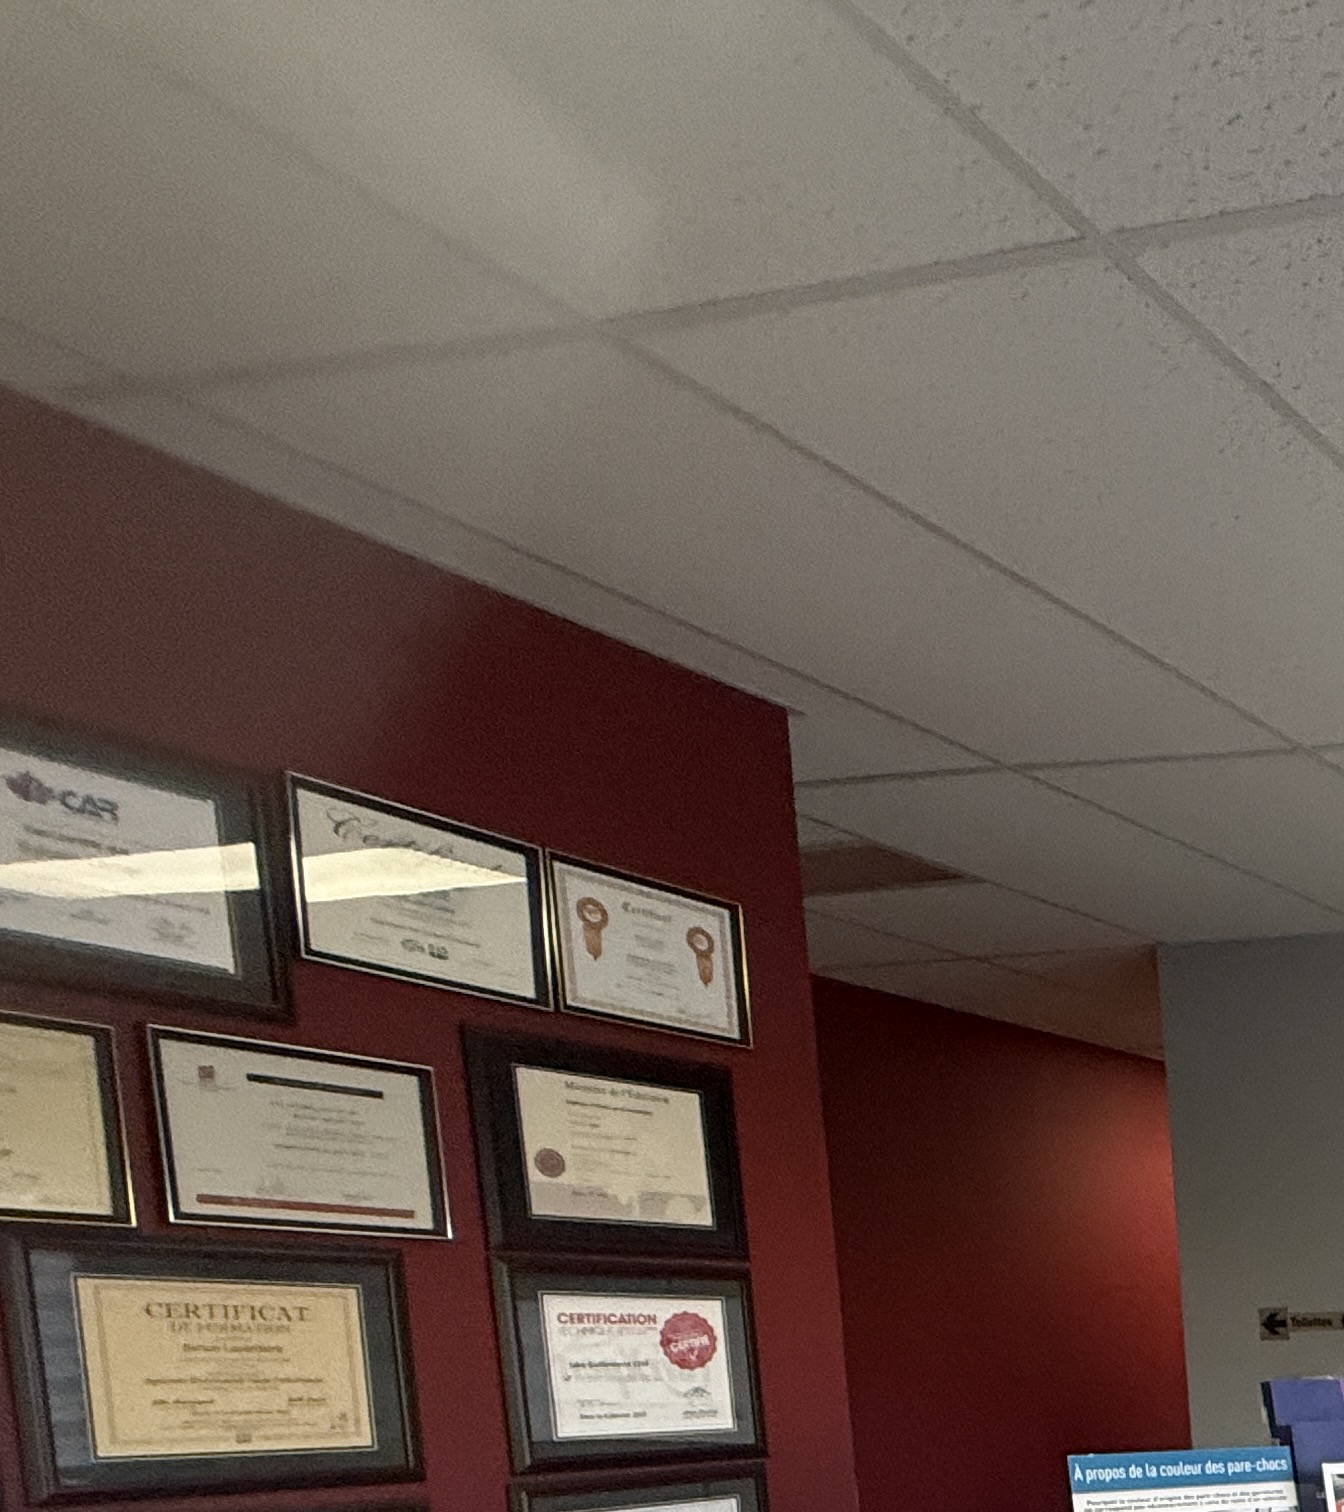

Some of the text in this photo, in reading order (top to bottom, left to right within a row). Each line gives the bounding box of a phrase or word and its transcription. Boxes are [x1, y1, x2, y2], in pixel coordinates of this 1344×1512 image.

[144, 1301, 313, 1323] CERTIFICAT
[557, 1312, 658, 1326] CERTIFICATION
[1074, 1457, 1288, 1484] À propos de la couleur des pare-chocs
